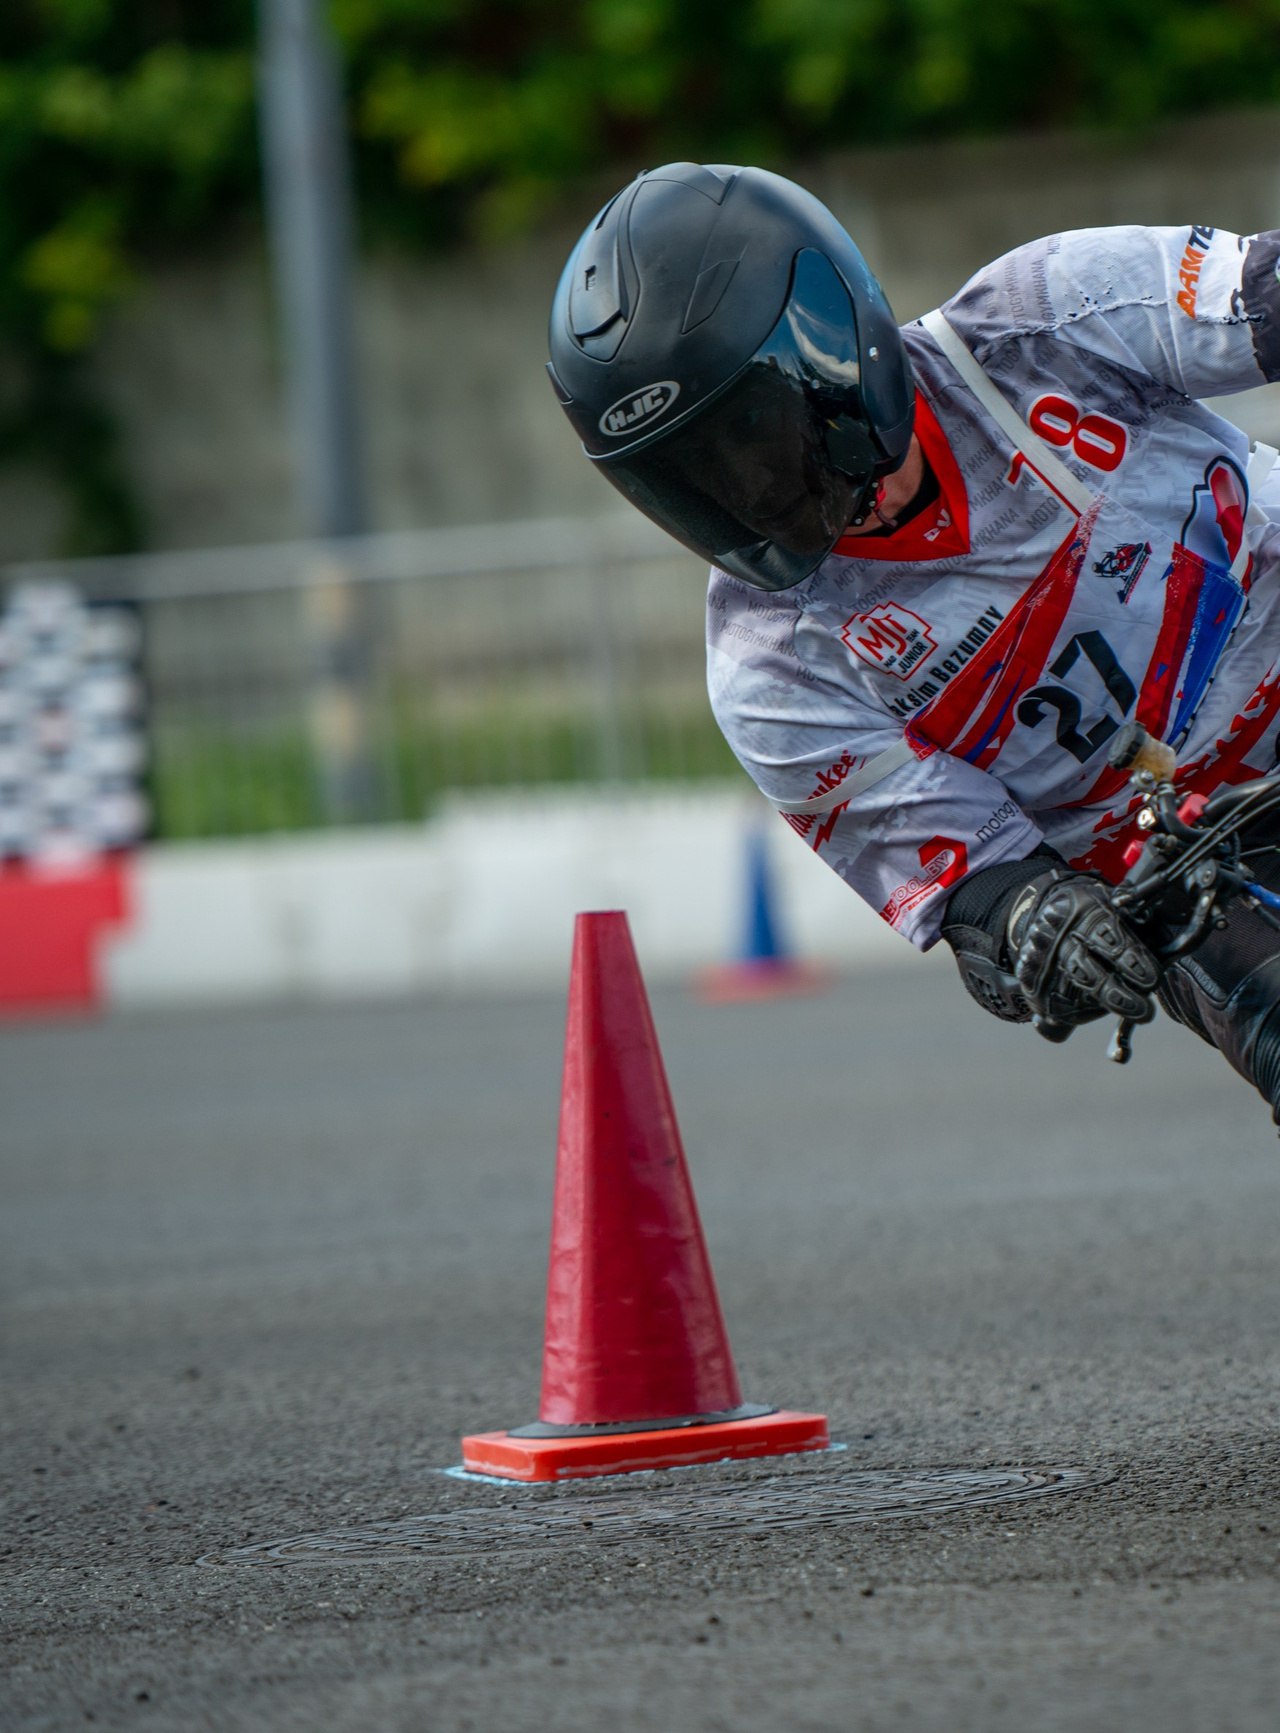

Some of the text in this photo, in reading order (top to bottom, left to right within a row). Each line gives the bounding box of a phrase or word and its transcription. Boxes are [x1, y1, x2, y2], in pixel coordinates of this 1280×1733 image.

[608, 387, 664, 431] HJC
[897, 641, 928, 674] JUNIOR
[905, 629, 920, 644] TEAM
[929, 605, 1004, 683] Bezumny
[1016, 630, 1137, 764] 27
[879, 850, 951, 924] REDOOL.BY
